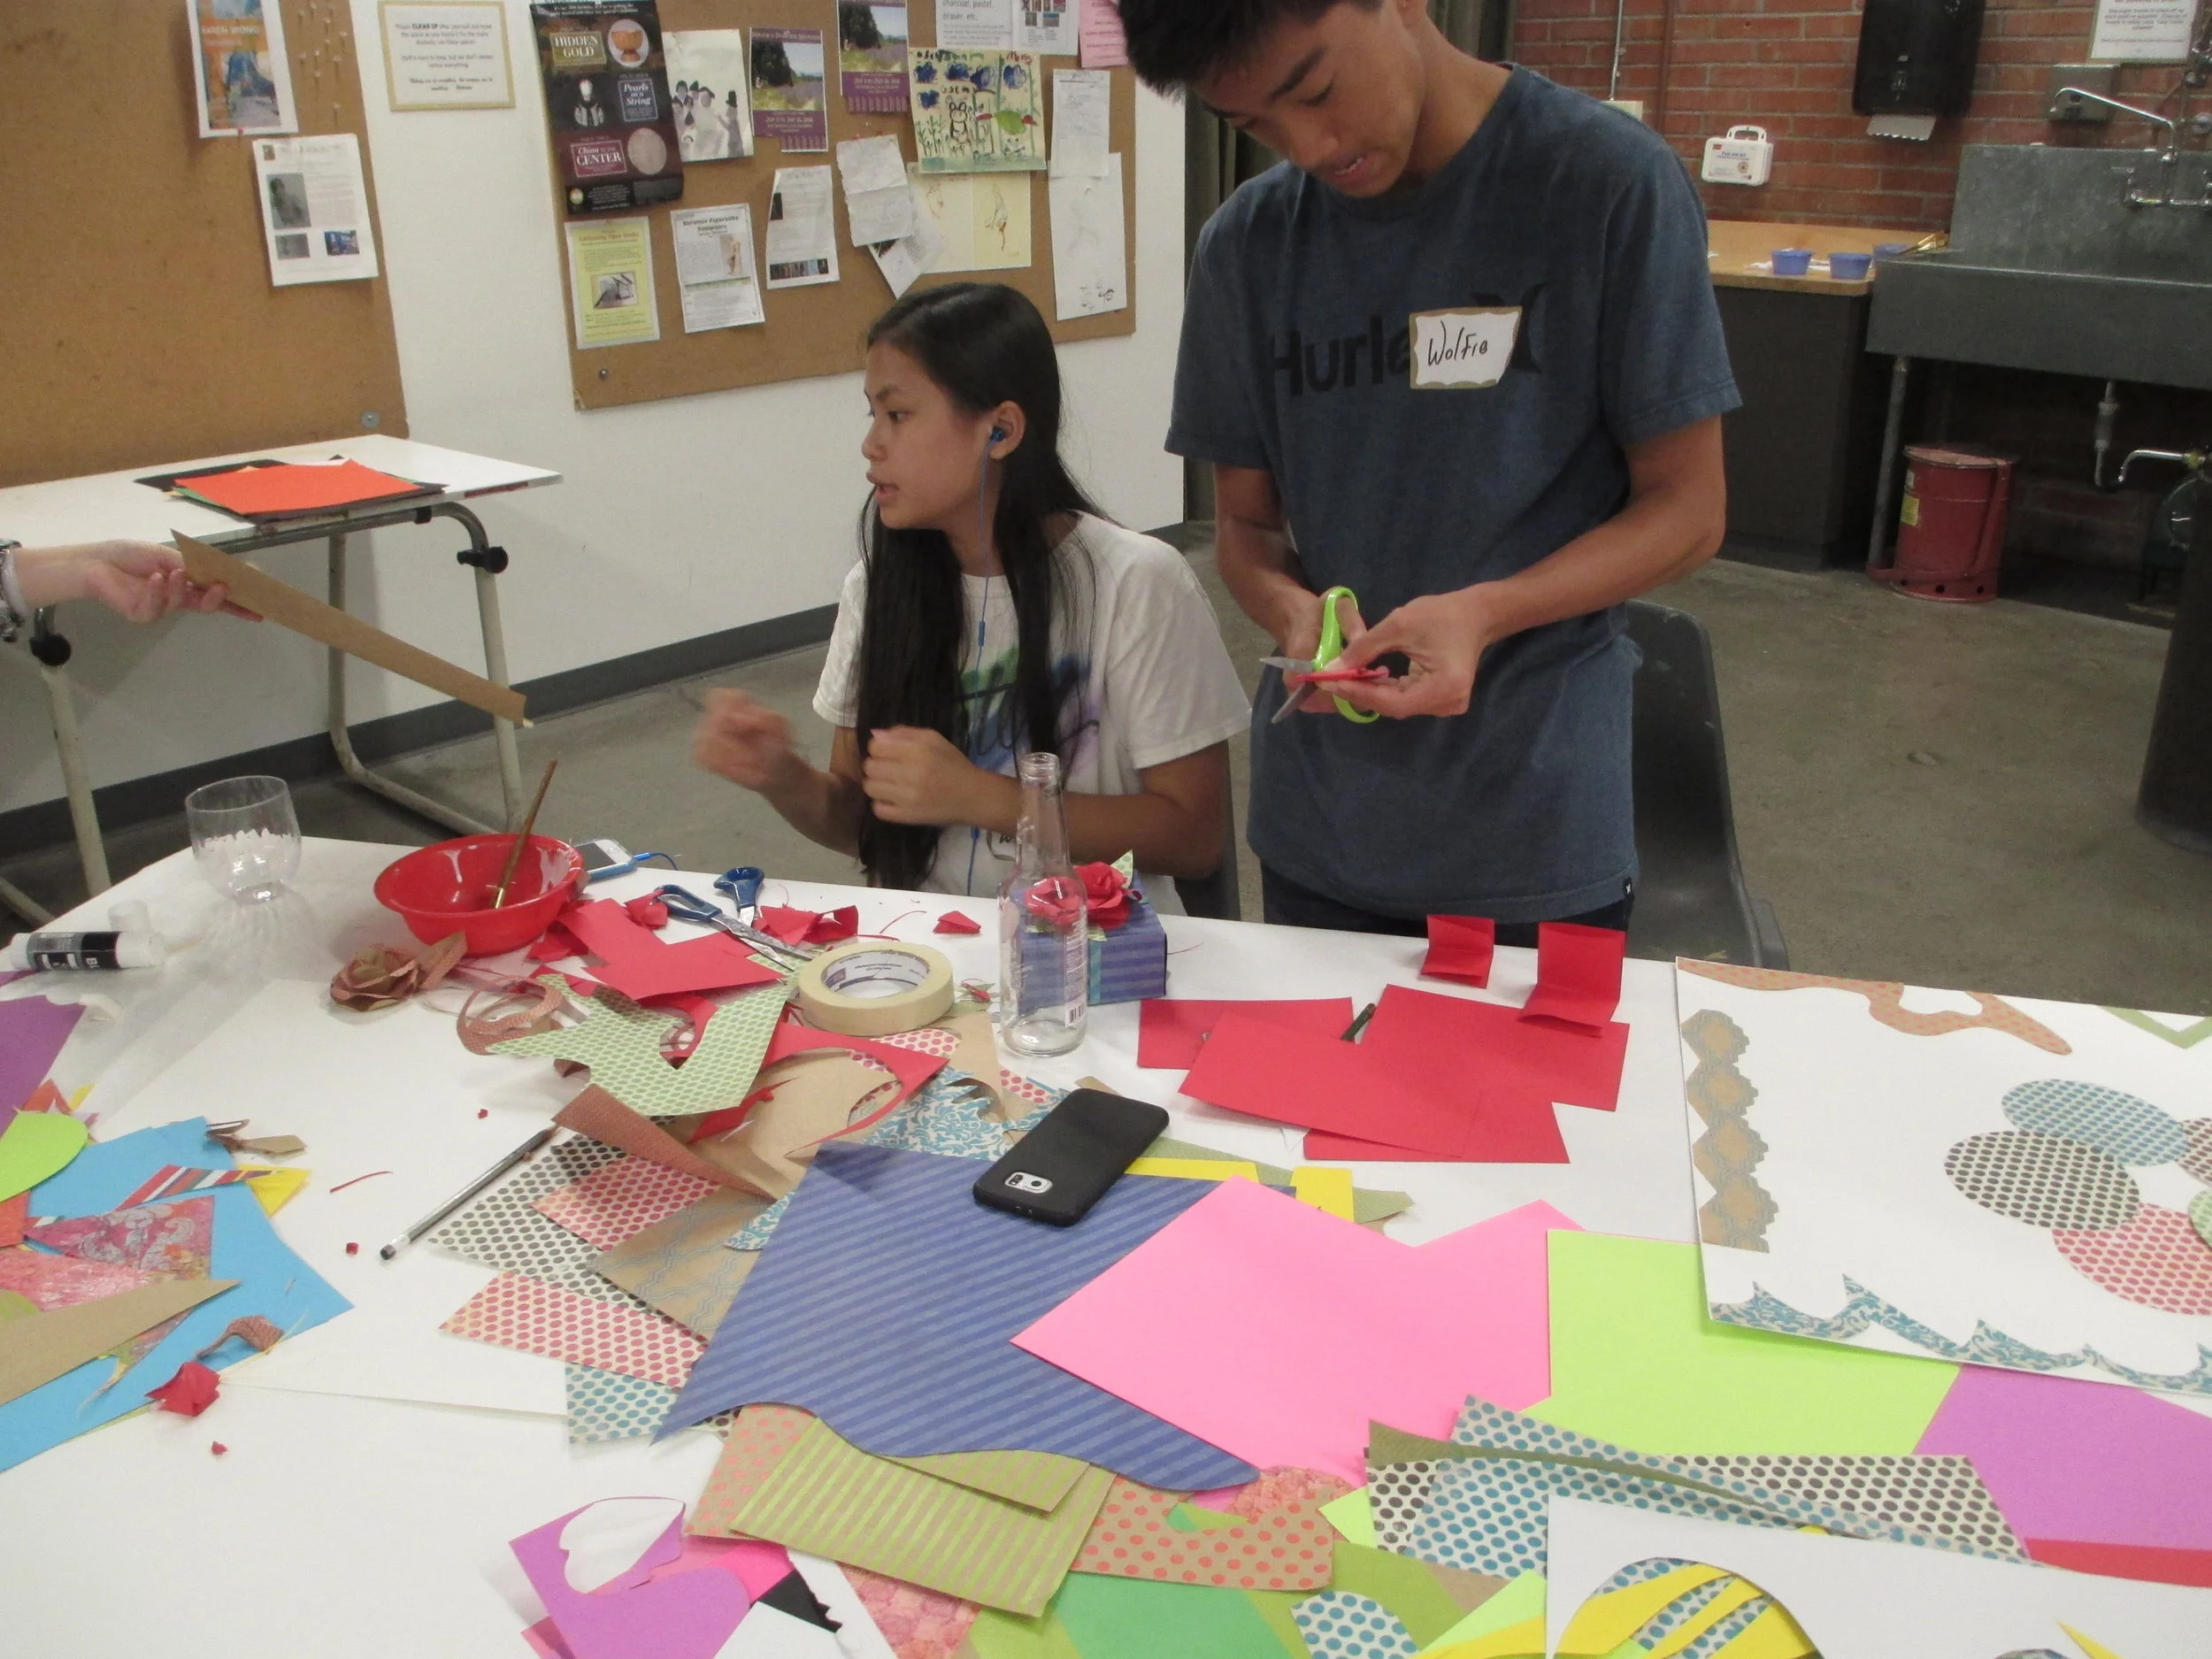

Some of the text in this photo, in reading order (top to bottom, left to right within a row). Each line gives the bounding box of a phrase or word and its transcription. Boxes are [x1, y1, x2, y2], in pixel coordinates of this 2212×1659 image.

[555, 35, 599, 47] HIDDEN
[563, 46, 595, 58] GOLD
[624, 82, 649, 93] Pearls
[626, 97, 651, 106] String
[578, 145, 600, 155] China
[576, 151, 621, 166] CENTER
[1271, 315, 1410, 396] Hurle
